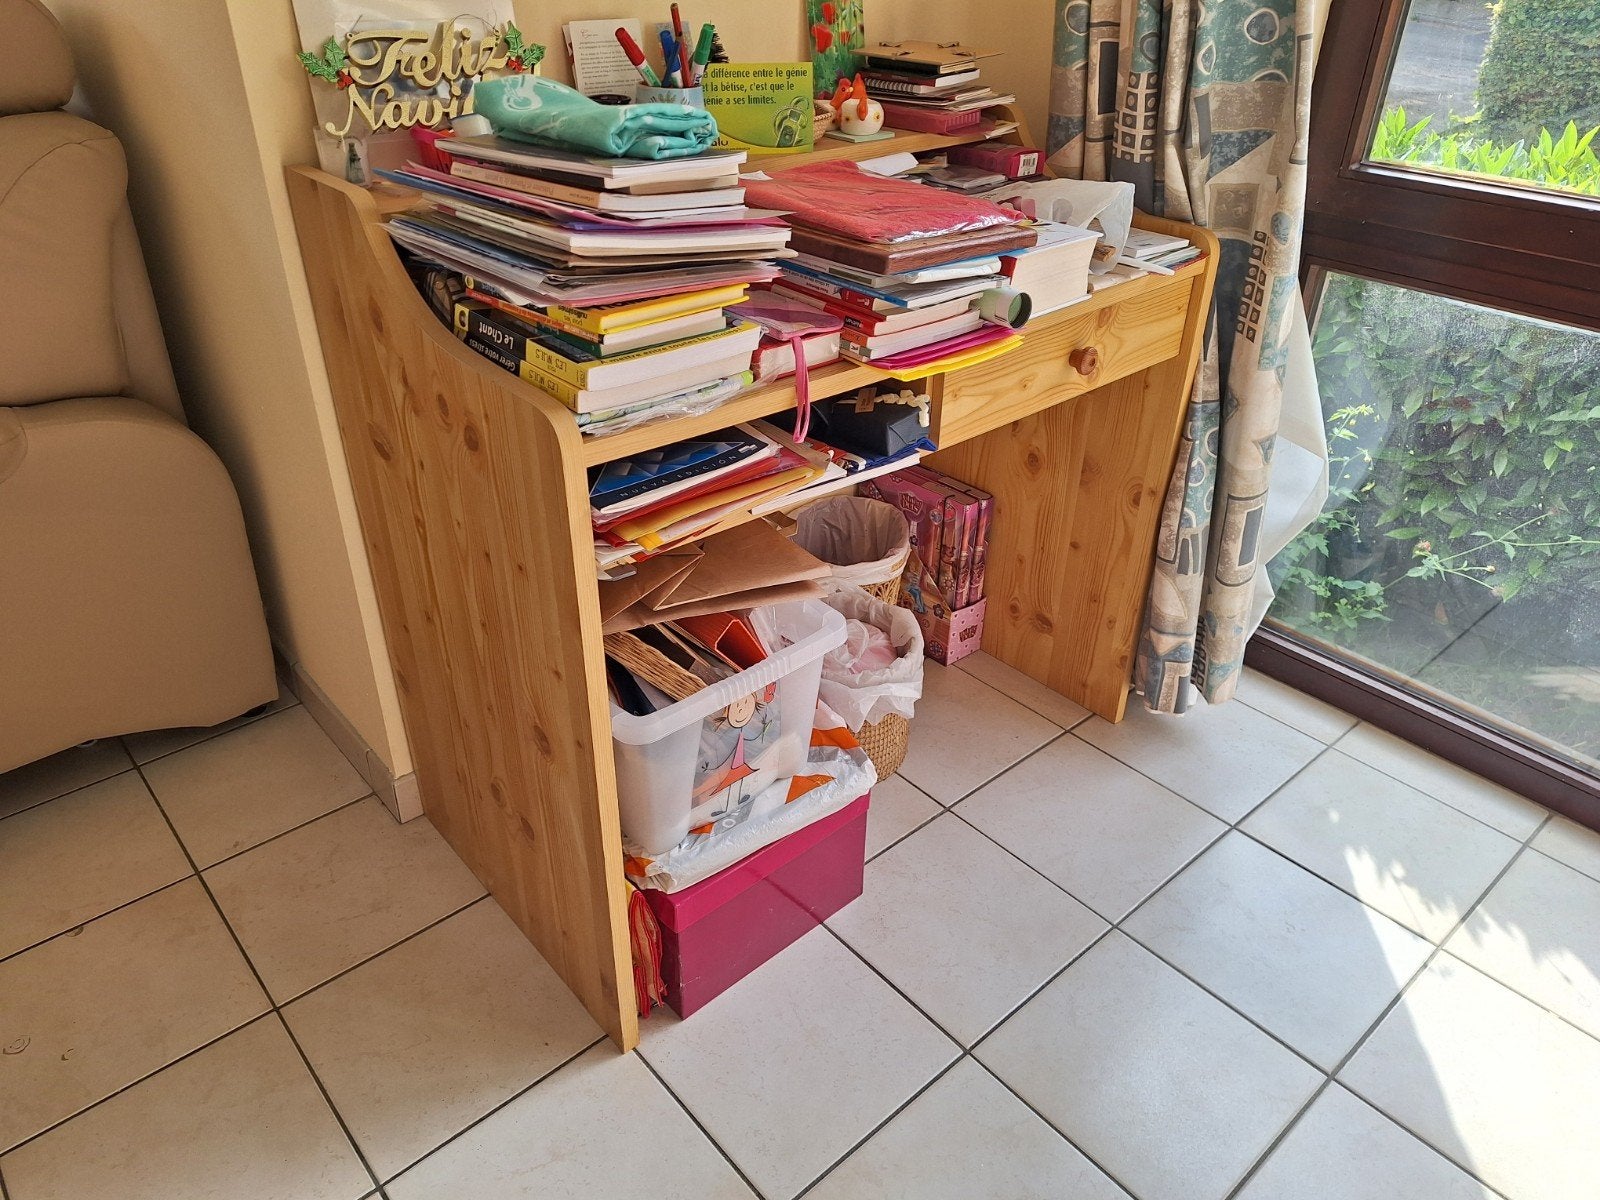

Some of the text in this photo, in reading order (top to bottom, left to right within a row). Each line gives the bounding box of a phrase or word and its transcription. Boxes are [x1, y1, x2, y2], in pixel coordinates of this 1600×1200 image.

[346, 21, 508, 87] Feliz
[711, 68, 750, 79] différence
[752, 68, 773, 78] entre
[775, 68, 784, 77] le
[786, 67, 808, 79] génie
[711, 82, 719, 92] la
[749, 82, 767, 91] c'est
[769, 82, 784, 92] que
[787, 80, 795, 90] le
[725, 97, 731, 105] a
[733, 97, 746, 105] ses
[748, 95, 777, 105] limites.
[325, 84, 475, 137] Navi
[479, 321, 514, 350] Le Chant
[484, 345, 500, 361] votre
[499, 350, 516, 372] Gérer
[619, 479, 668, 497] NUEVA
